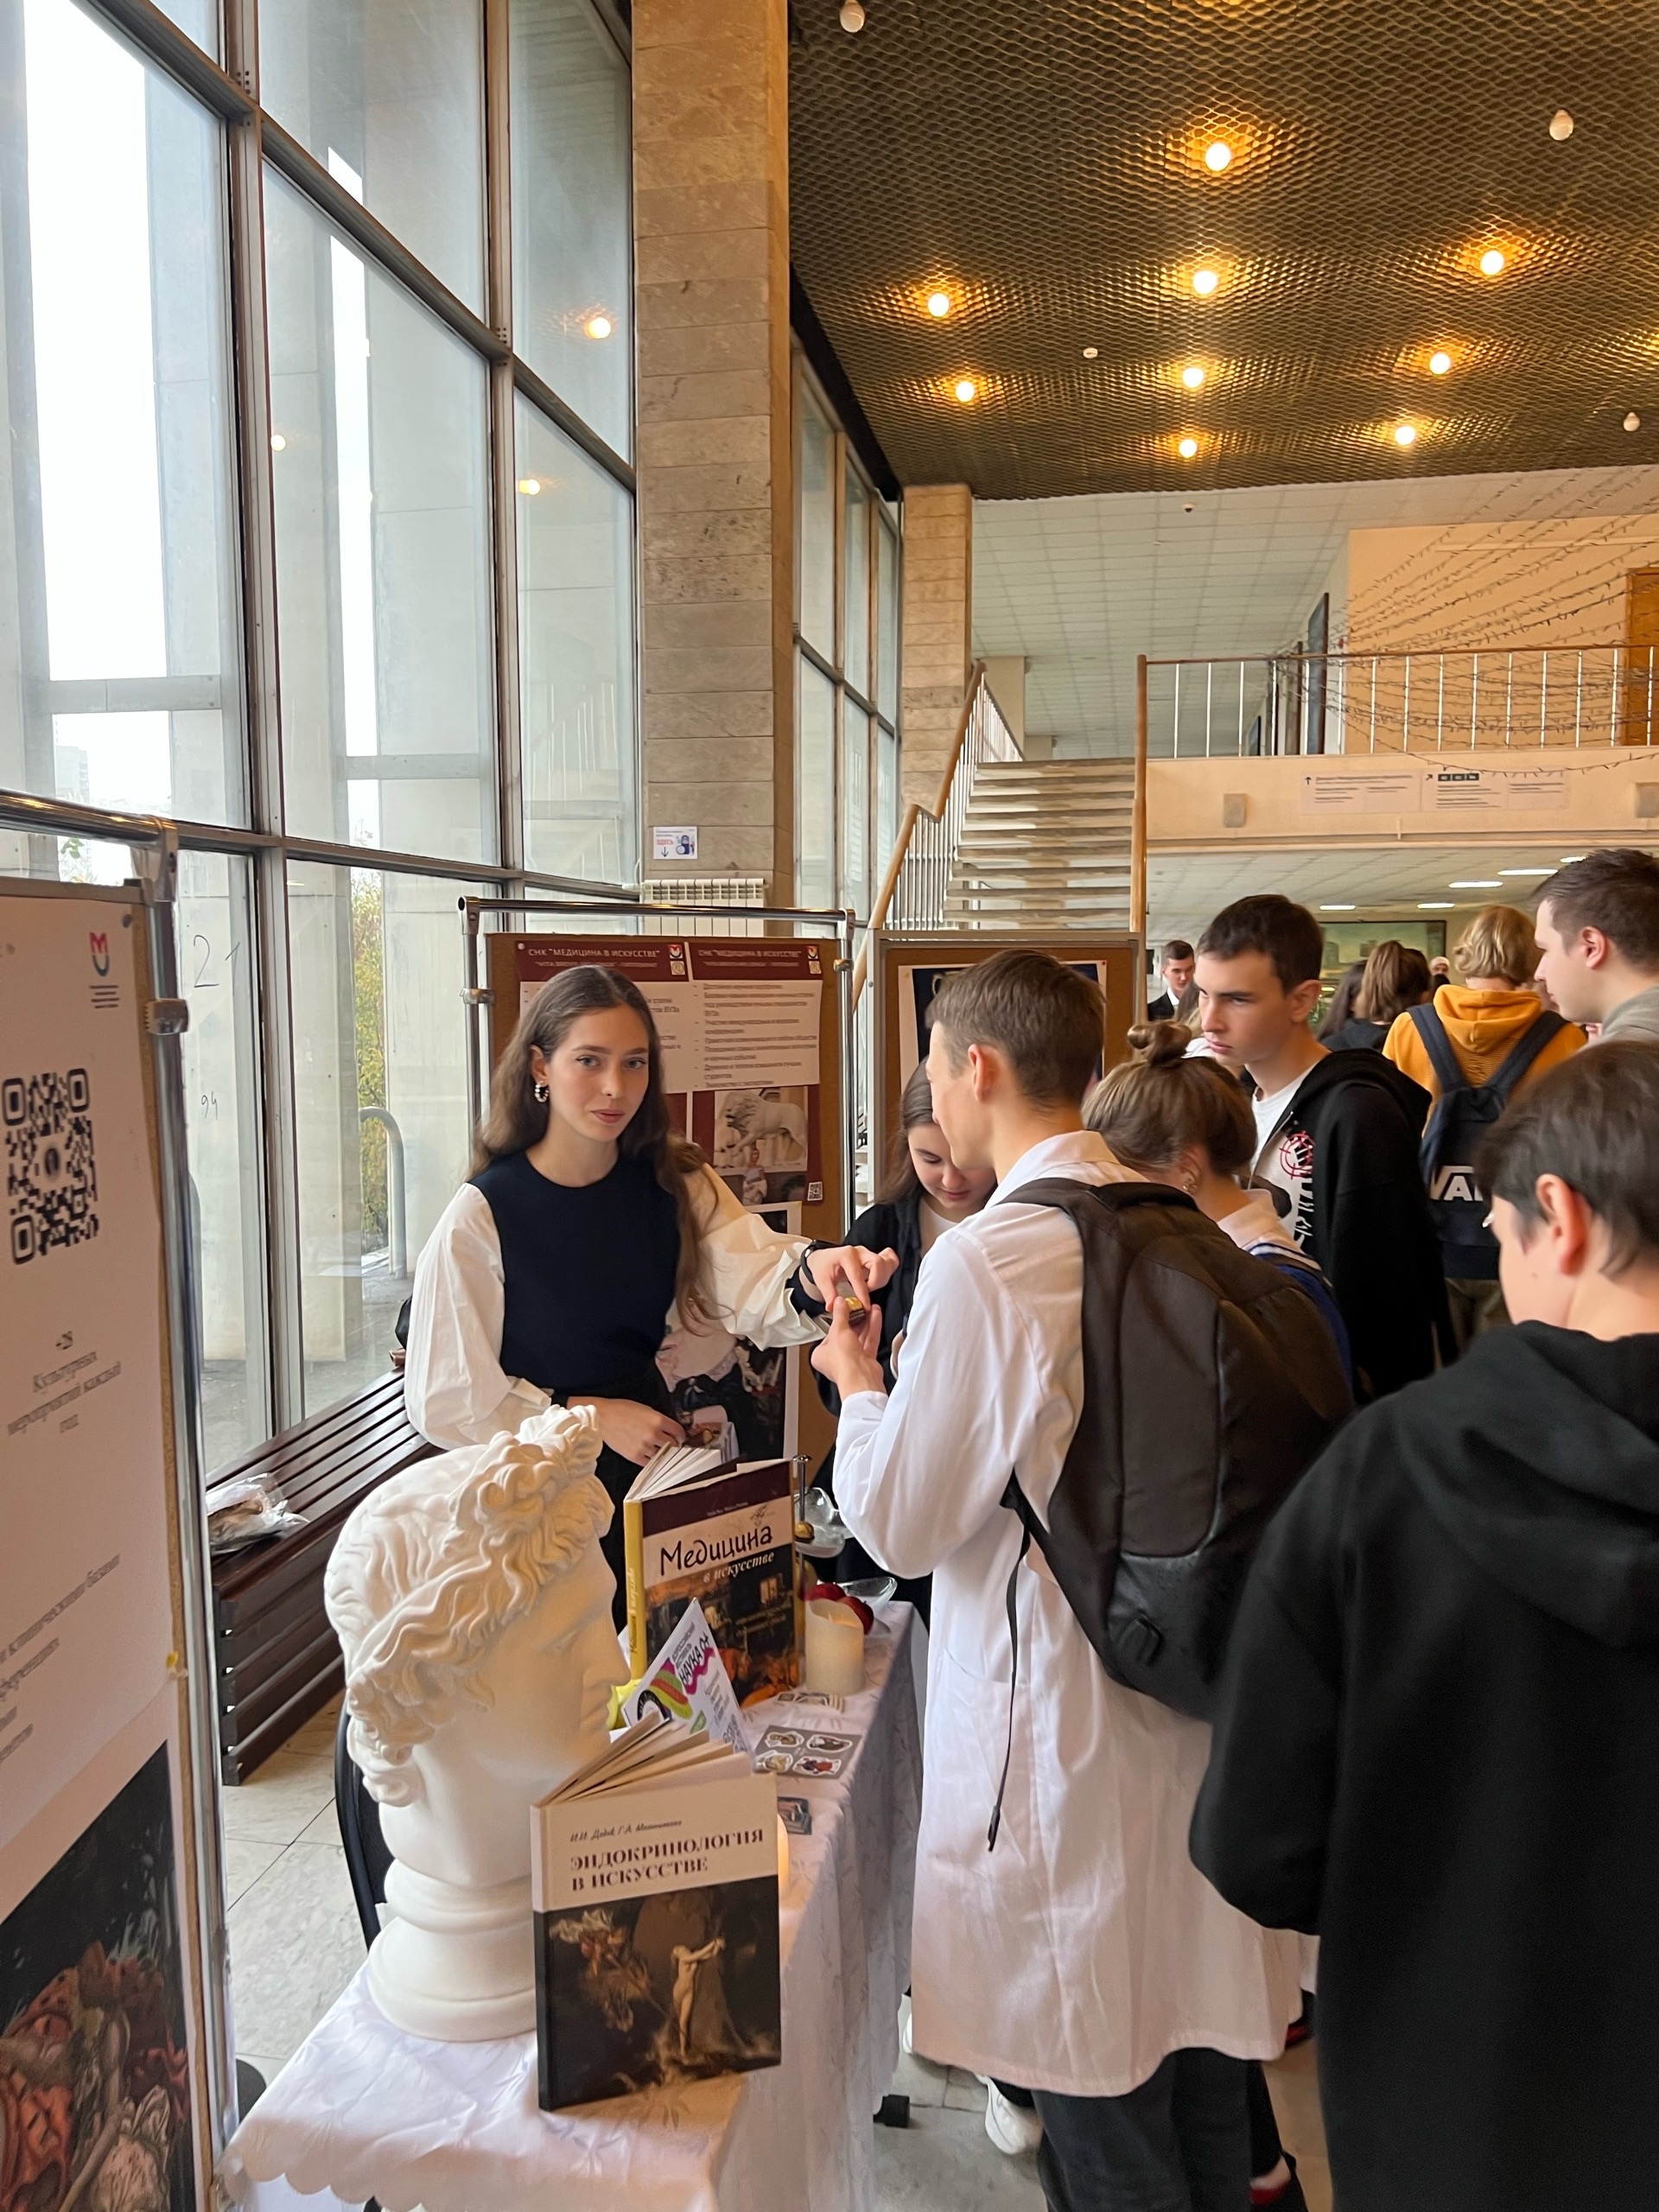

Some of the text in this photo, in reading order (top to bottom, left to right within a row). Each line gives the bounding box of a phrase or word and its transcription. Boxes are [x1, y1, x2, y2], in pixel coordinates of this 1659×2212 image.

[660, 1525, 773, 1576] Медицина
[702, 1551, 775, 1583] в искусстве
[677, 1645, 703, 1685] НАУКА
[570, 1829, 764, 1872] ЭНДОКРИНОЛОГИЯ
[572, 1858, 709, 1891] В ИСКУССТВЕ
